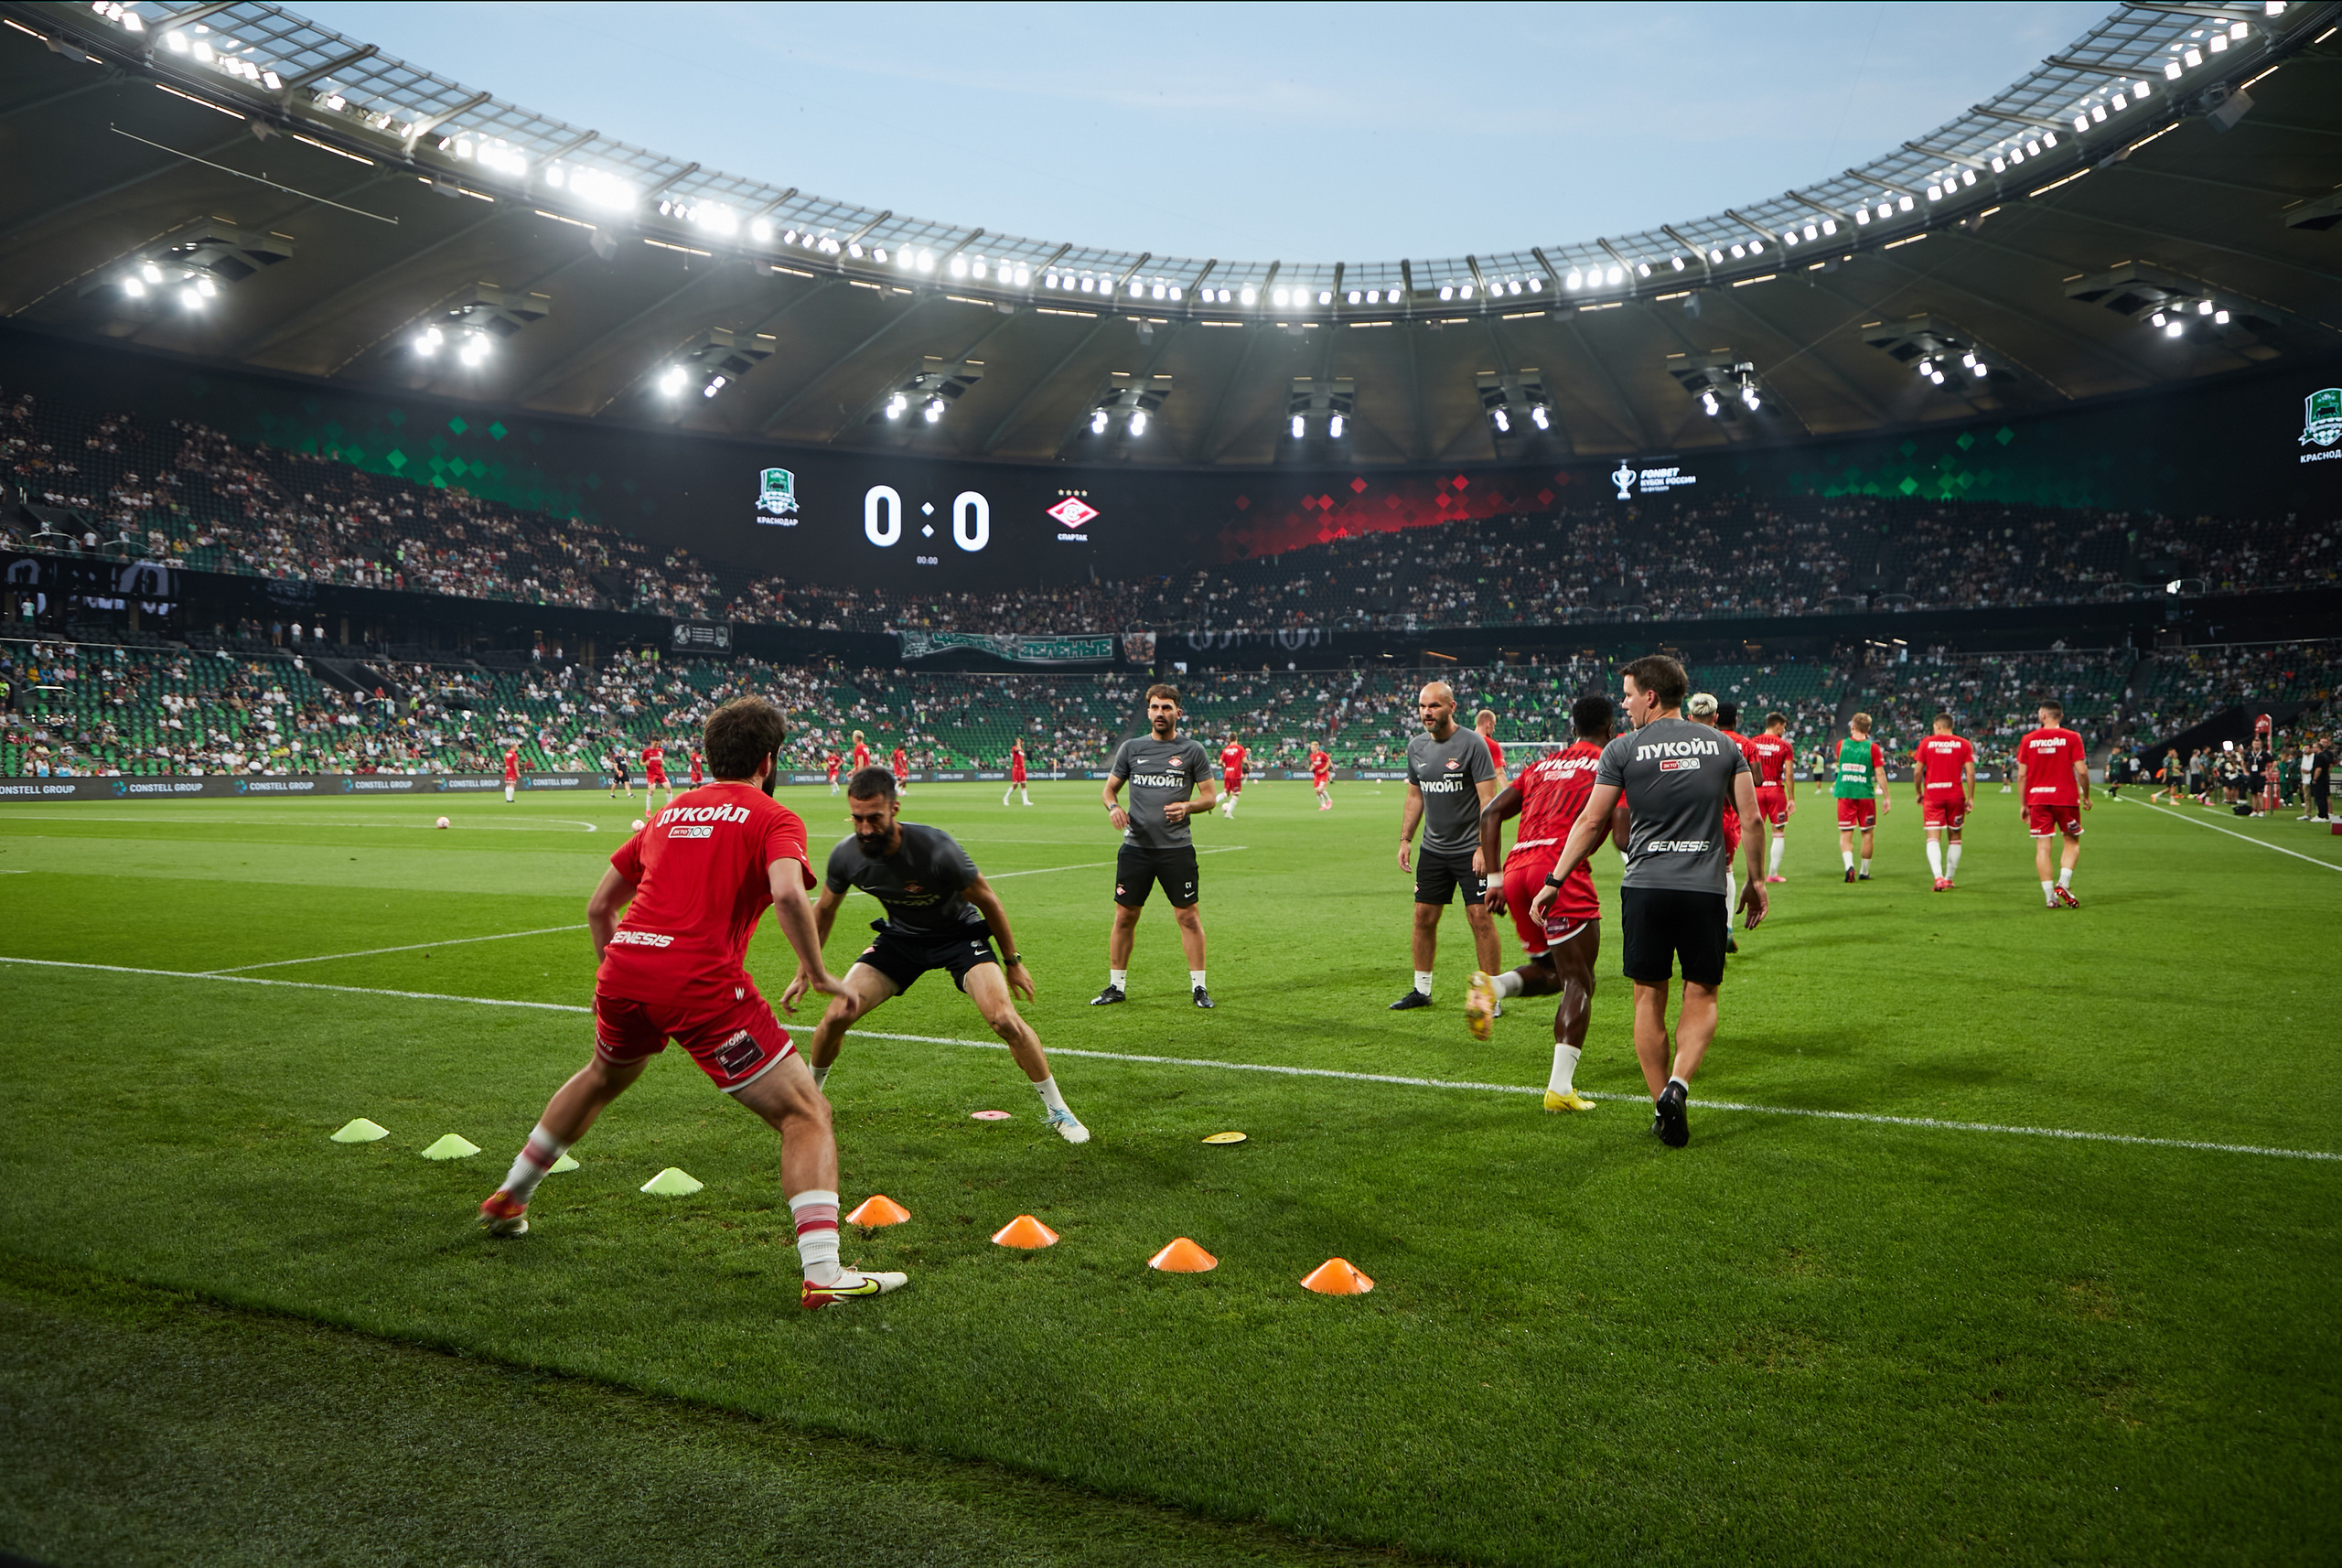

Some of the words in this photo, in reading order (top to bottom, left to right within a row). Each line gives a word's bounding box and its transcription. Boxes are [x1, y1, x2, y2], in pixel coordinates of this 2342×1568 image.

[2300, 449, 2342, 464] КРАСНОД
[1665, 476, 1696, 485] РОССИИ
[757, 516, 799, 527] КРАСНОДАР
[865, 485, 901, 547] 0
[953, 490, 990, 552] 0
[1058, 533, 1089, 542] СПАРТАК
[917, 556, 939, 564] 00:00
[1928, 739, 1961, 748] ЛУКОЙЛ
[2029, 736, 2067, 748] ЛУКОЙЛ
[1636, 737, 1720, 761] ЛУКОЙЛ
[1756, 743, 1780, 752] УКОЙЛ
[1534, 756, 1599, 772] ЛУКОЙЛ
[390, 780, 413, 789] GROUP
[448, 779, 479, 788] CONSTELL
[480, 779, 500, 787] GROUP
[532, 778, 560, 786] CONSTELL
[560, 778, 580, 786] GROUP
[1133, 774, 1184, 787] ЛУКОЙЛ
[43, 785, 76, 794] GROUP
[129, 783, 173, 792] CONSTELL
[174, 783, 203, 791] GROUP
[249, 782, 288, 790] CONSTELL
[288, 781, 315, 789] GROUP
[657, 803, 751, 828] ЛУКОЙЛ
[1647, 841, 1710, 853] GENESIS
